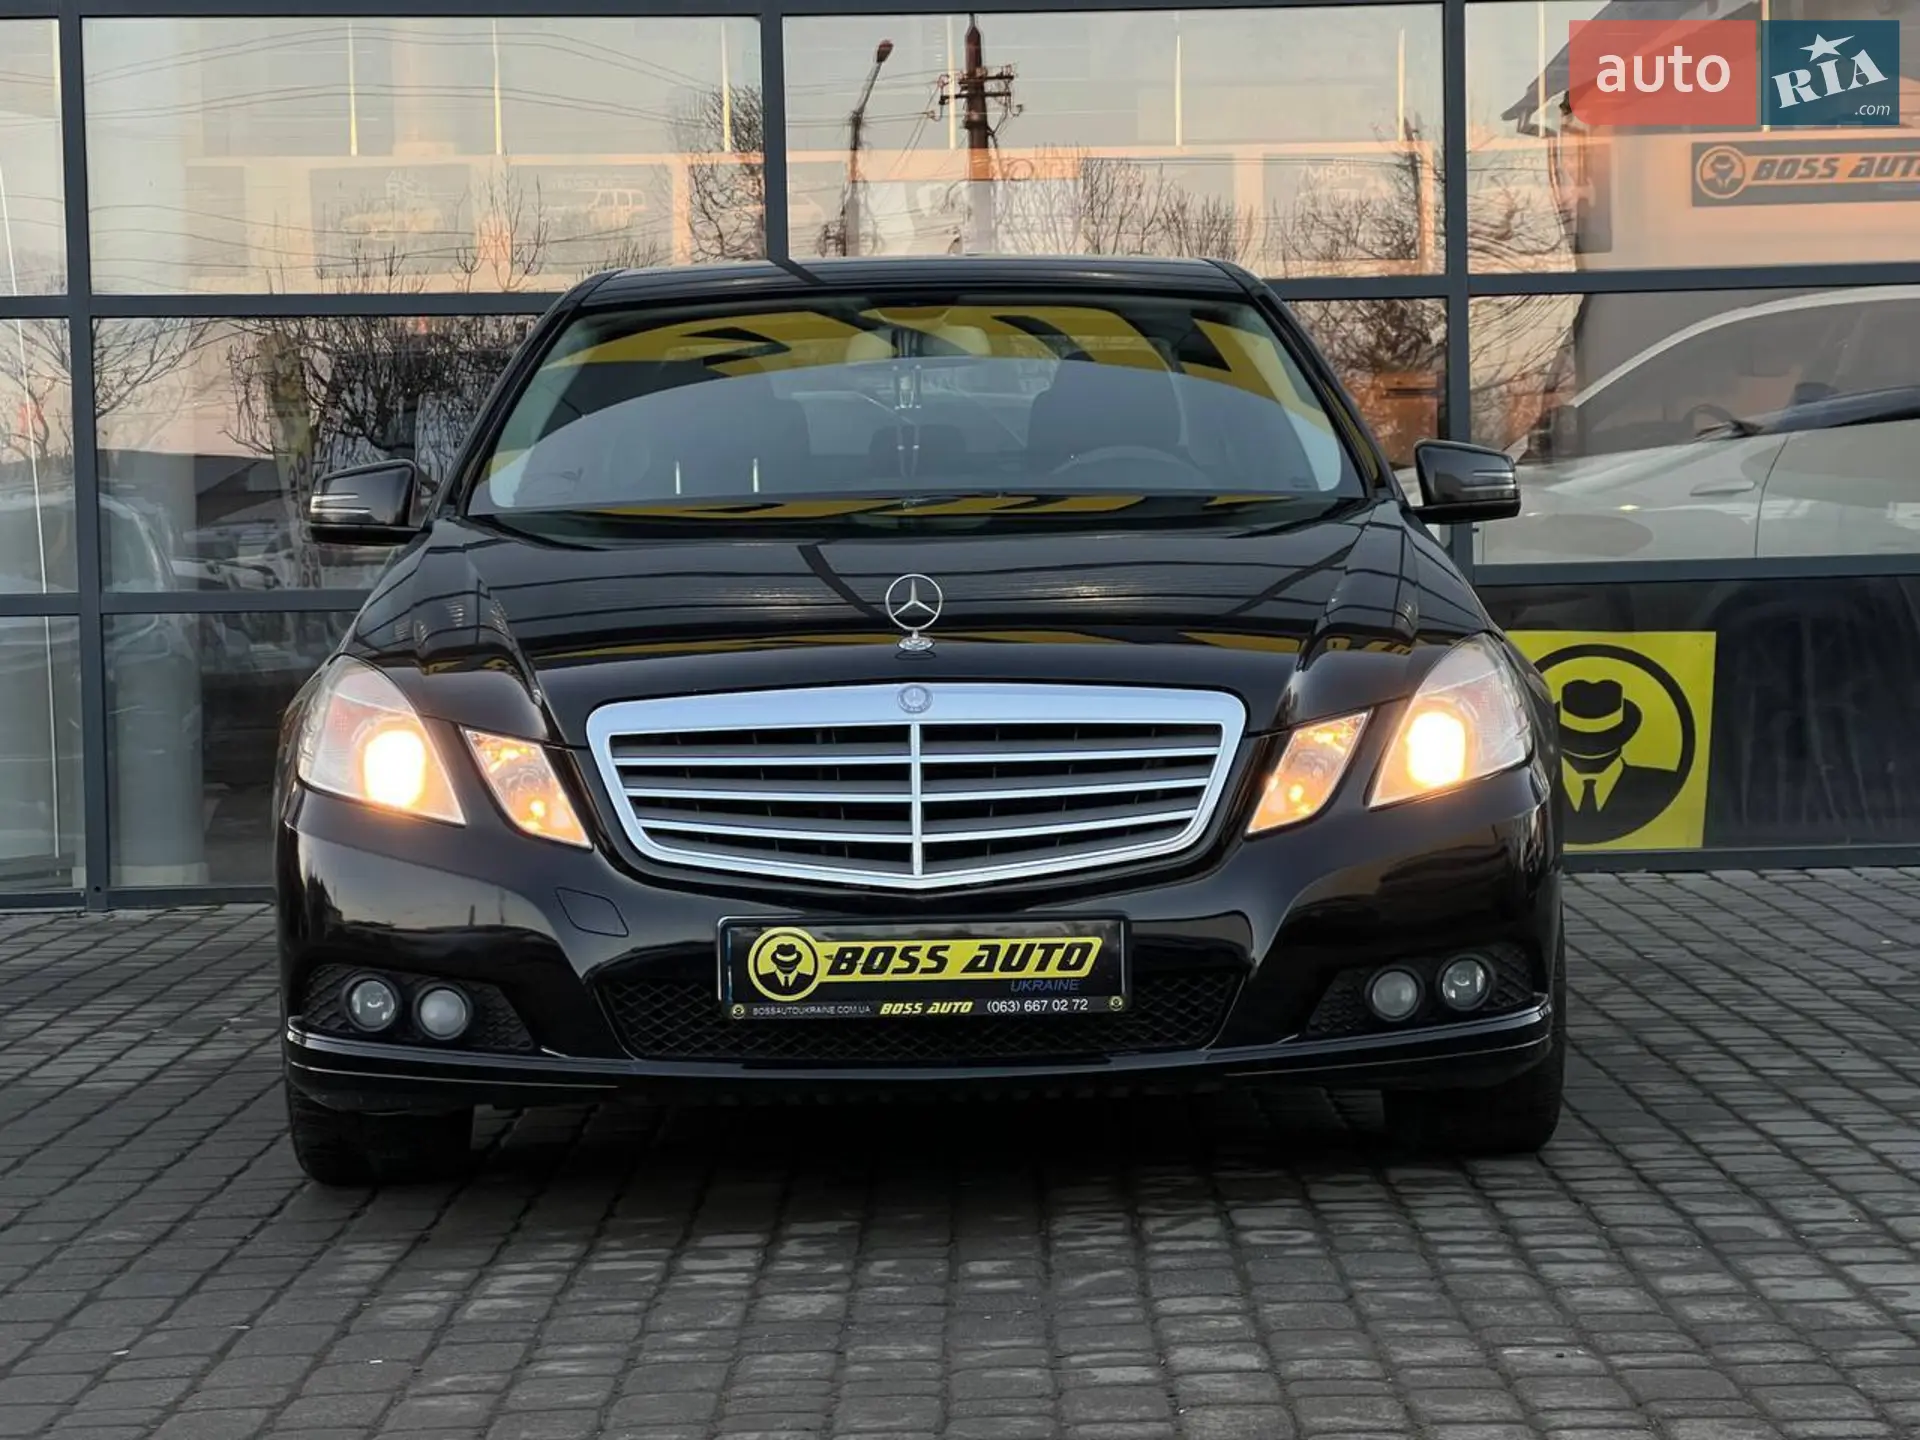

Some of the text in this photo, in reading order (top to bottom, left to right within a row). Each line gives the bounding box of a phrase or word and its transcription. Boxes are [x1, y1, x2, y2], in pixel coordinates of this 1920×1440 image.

[1751, 154, 1920, 181] BOSS AUT
[826, 942, 1094, 976] BOSS AUTO
[1010, 979, 1081, 992] UKRAINE
[880, 1001, 974, 1015] BOSS AUTO
[986, 998, 1089, 1014] (063) 667 02 72
